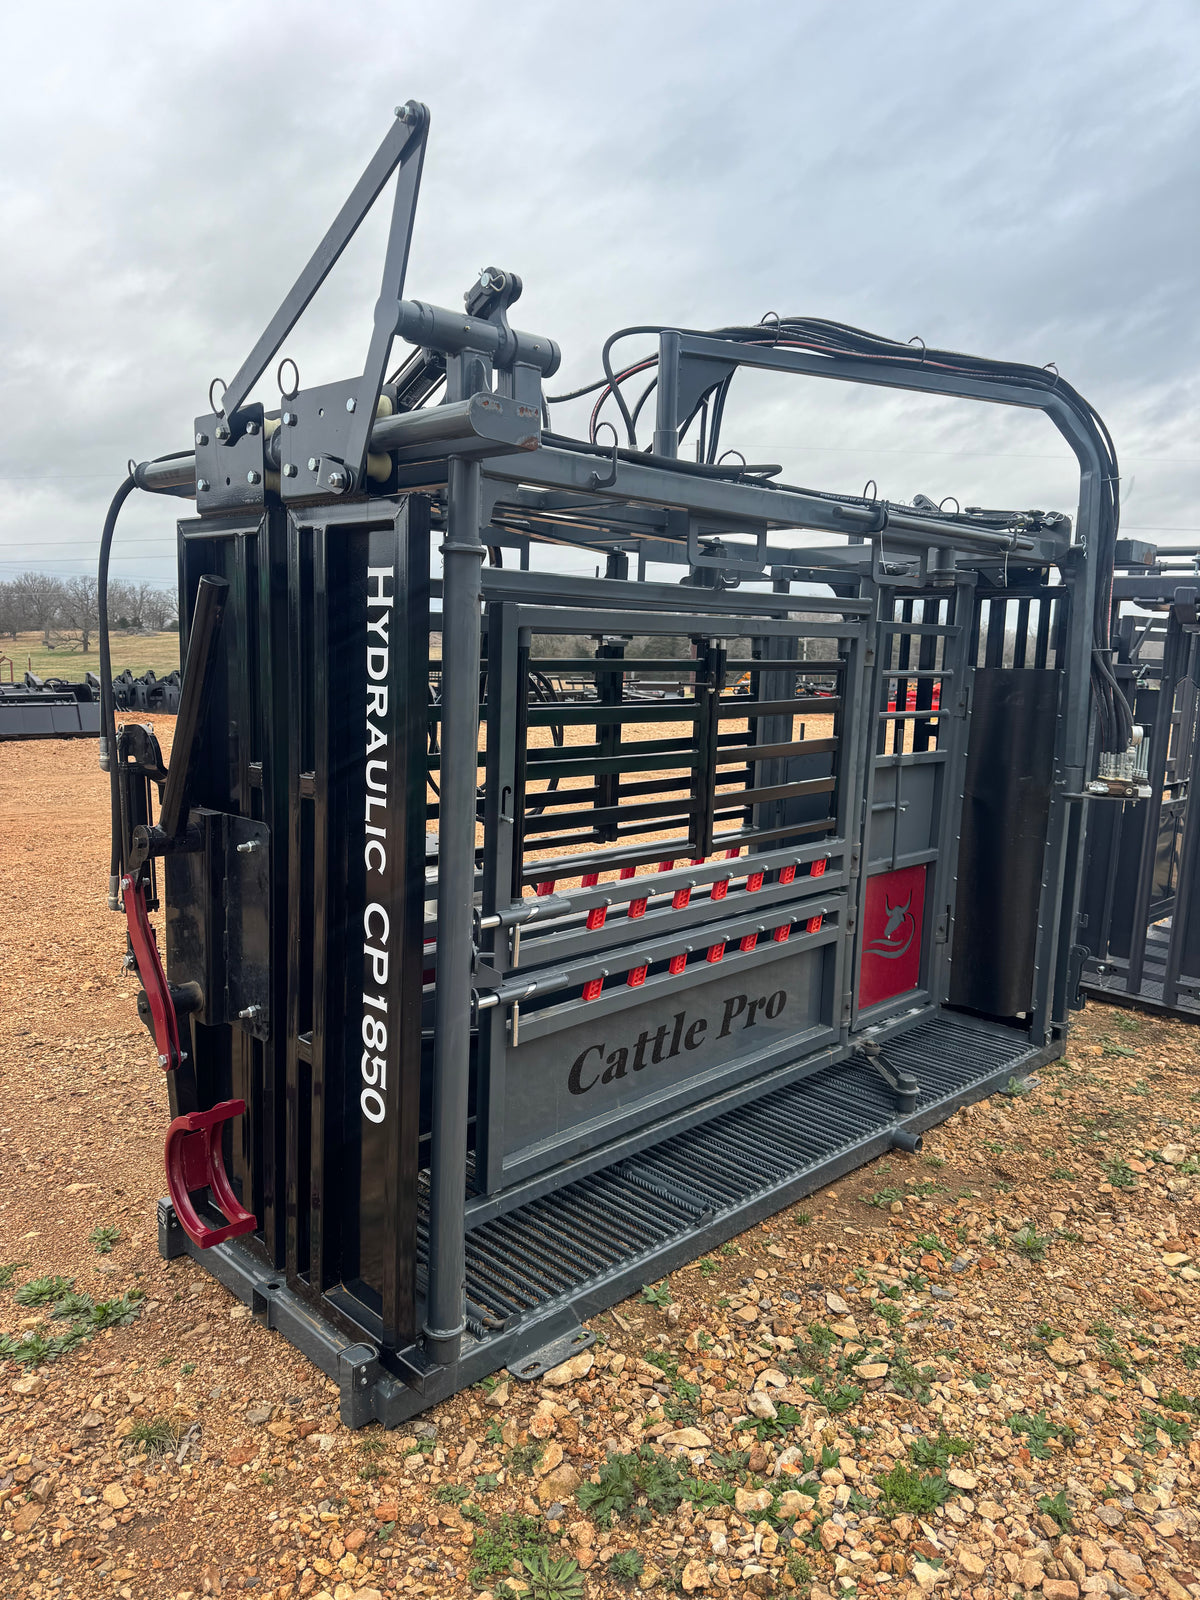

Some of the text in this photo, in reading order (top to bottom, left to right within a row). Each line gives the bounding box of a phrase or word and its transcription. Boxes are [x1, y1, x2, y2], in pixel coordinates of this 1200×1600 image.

[360, 565, 394, 1124] HYDRAULIC CP1850
[567, 990, 788, 1095] Cattle Pro
